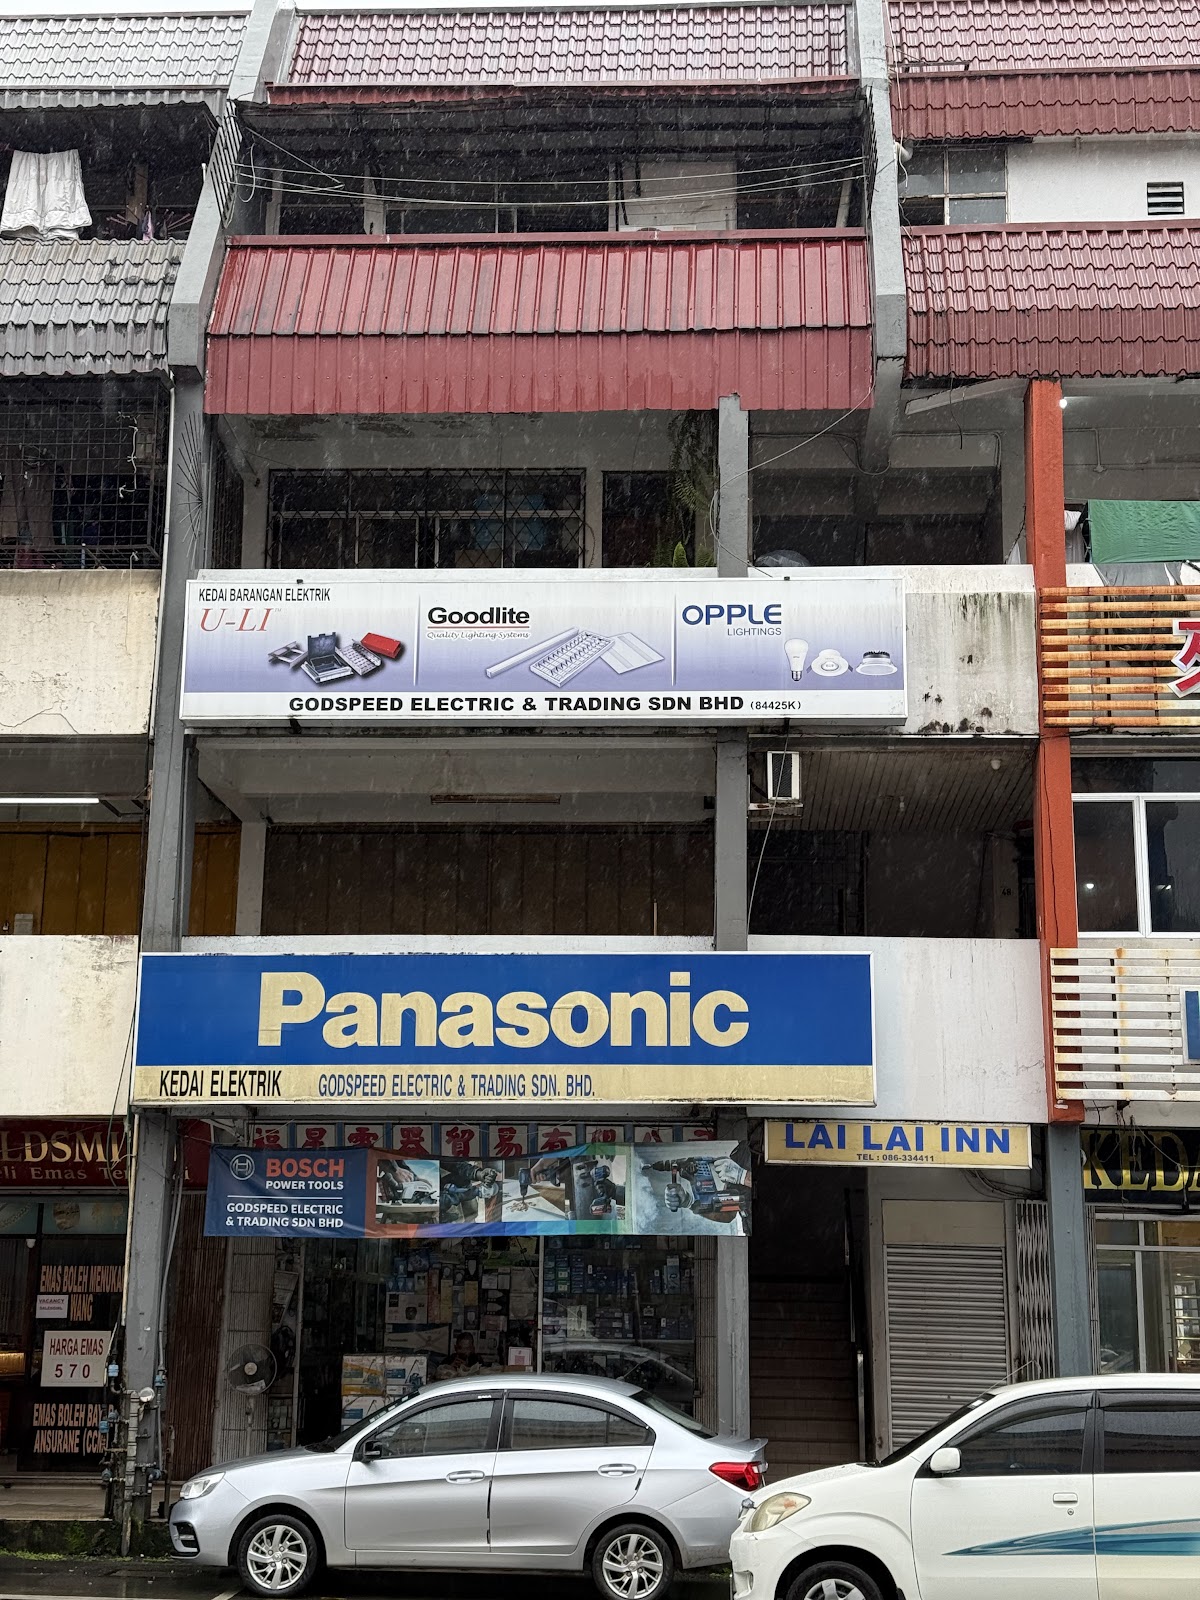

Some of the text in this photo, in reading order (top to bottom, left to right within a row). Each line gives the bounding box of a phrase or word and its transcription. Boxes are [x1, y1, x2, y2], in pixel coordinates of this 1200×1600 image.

[199, 588, 331, 602] KEDAI BARANGAN ELEKTRIK
[200, 608, 274, 632] U-LI
[427, 606, 530, 624] Goodlite
[682, 604, 782, 625] OPPLE
[427, 631, 530, 641] Quality Lighting Systems
[727, 628, 782, 637] LIGHTINGS
[289, 697, 802, 712] GODSPEED ELECTRIC & TRADING SDN BHD (84425K)
[258, 971, 750, 1048] Panasonic
[159, 1070, 282, 1097] KEDAI ELEKTRIK
[318, 1074, 595, 1097] GODSPEED ELECTRIC & TRADING SDN. BHD.
[785, 1123, 1010, 1153] LAI LAI INN
[856, 1153, 875, 1161] TEL
[882, 1154, 934, 1162] 086-334411
[0, 1166, 17, 1180] li
[31, 1167, 88, 1180] Emas
[266, 1158, 344, 1178] BOSCH
[265, 1180, 344, 1190] POWER TOOLS
[227, 1203, 344, 1215] GODSPEED ELECTRIC
[225, 1216, 344, 1228] & TRADING SDN BHD
[40, 1265, 62, 1292] EMAS
[62, 1265, 89, 1292] BOLEH
[70, 1294, 93, 1321] WANG
[49, 1338, 104, 1355] HARGA EMAS
[33, 1403, 57, 1426] EMAS
[57, 1403, 86, 1427] BOLEH
[33, 1429, 80, 1453] ANSURANE
